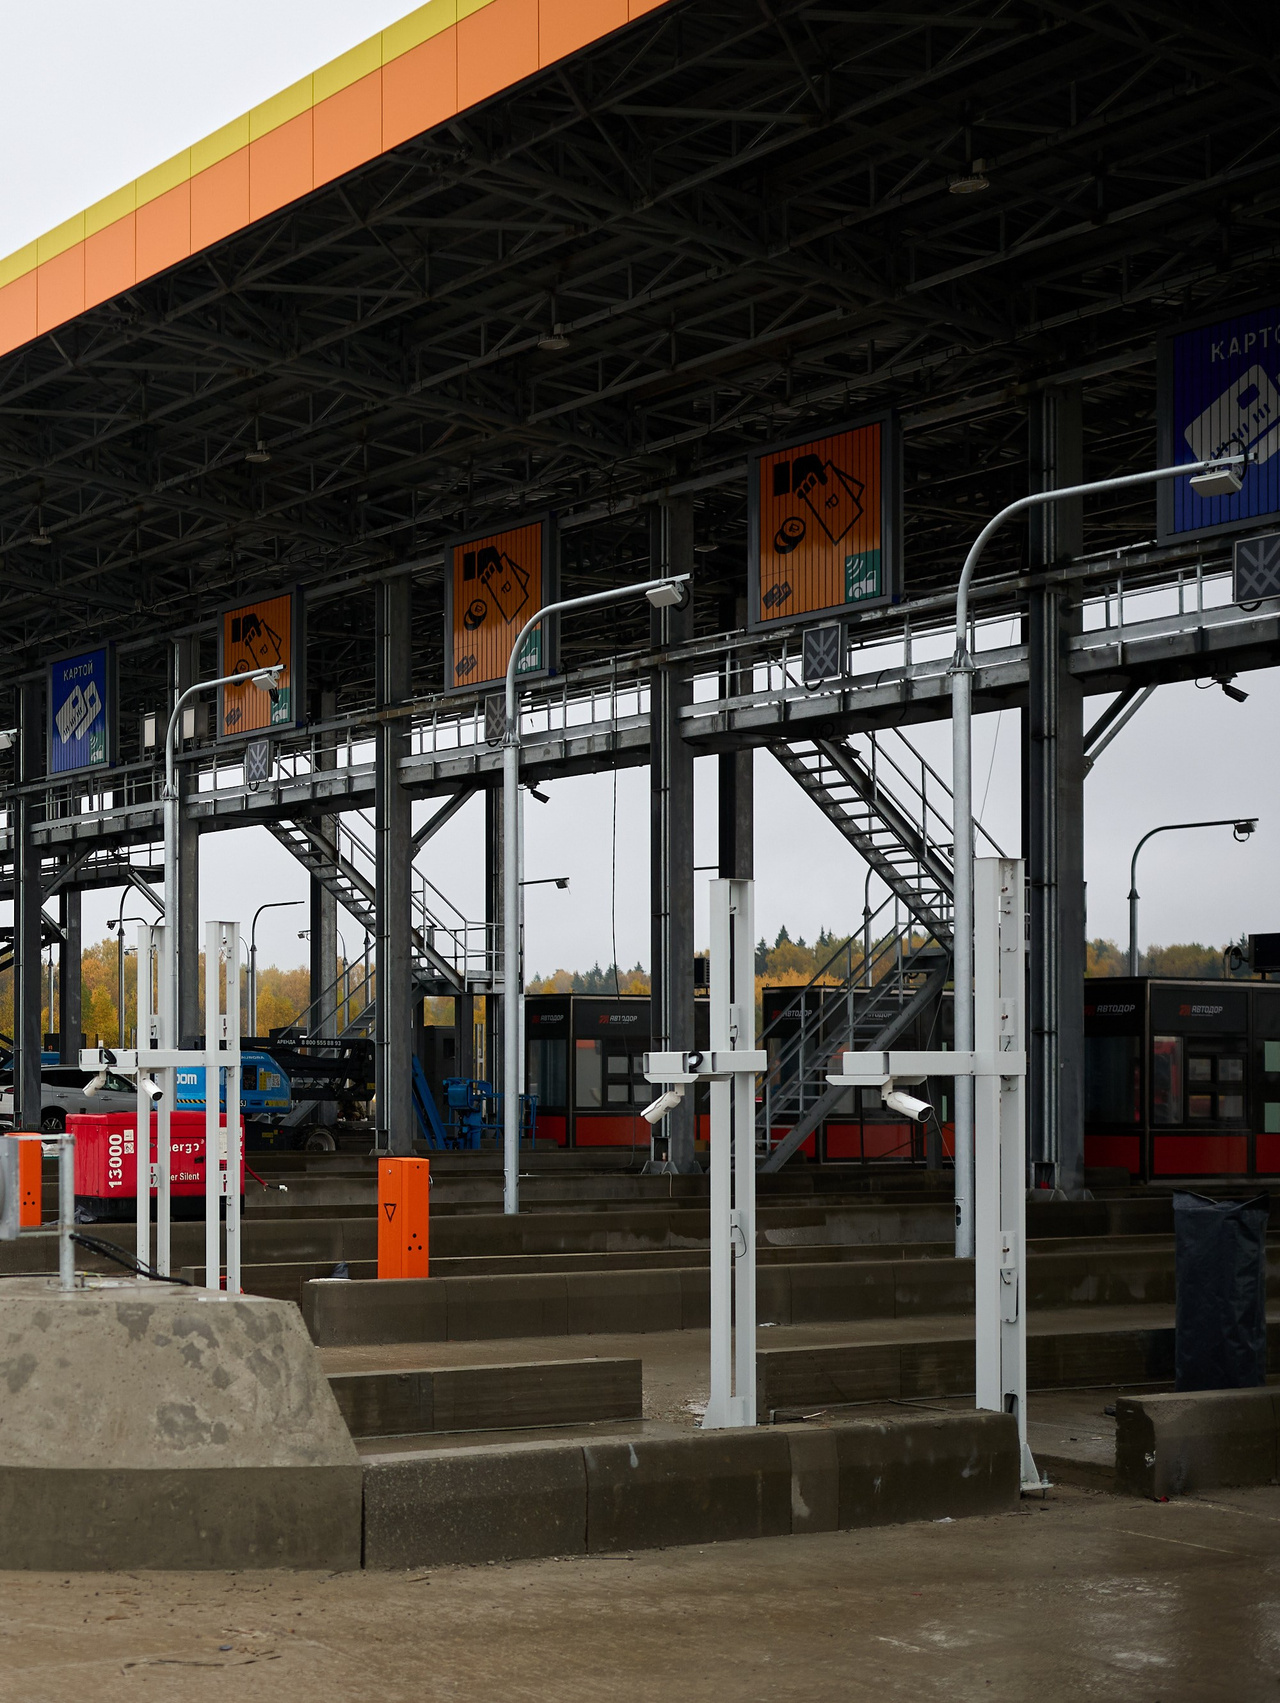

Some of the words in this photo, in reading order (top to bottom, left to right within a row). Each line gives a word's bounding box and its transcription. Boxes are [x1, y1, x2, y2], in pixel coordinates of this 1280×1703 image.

[64, 660, 93, 681] КАРТОЙ
[1097, 1004, 1135, 1013] АВТОДОР
[1191, 1005, 1223, 1013] АВТОДОР
[108, 1134, 123, 1188] 13000
[179, 1172, 200, 1181] Silent
